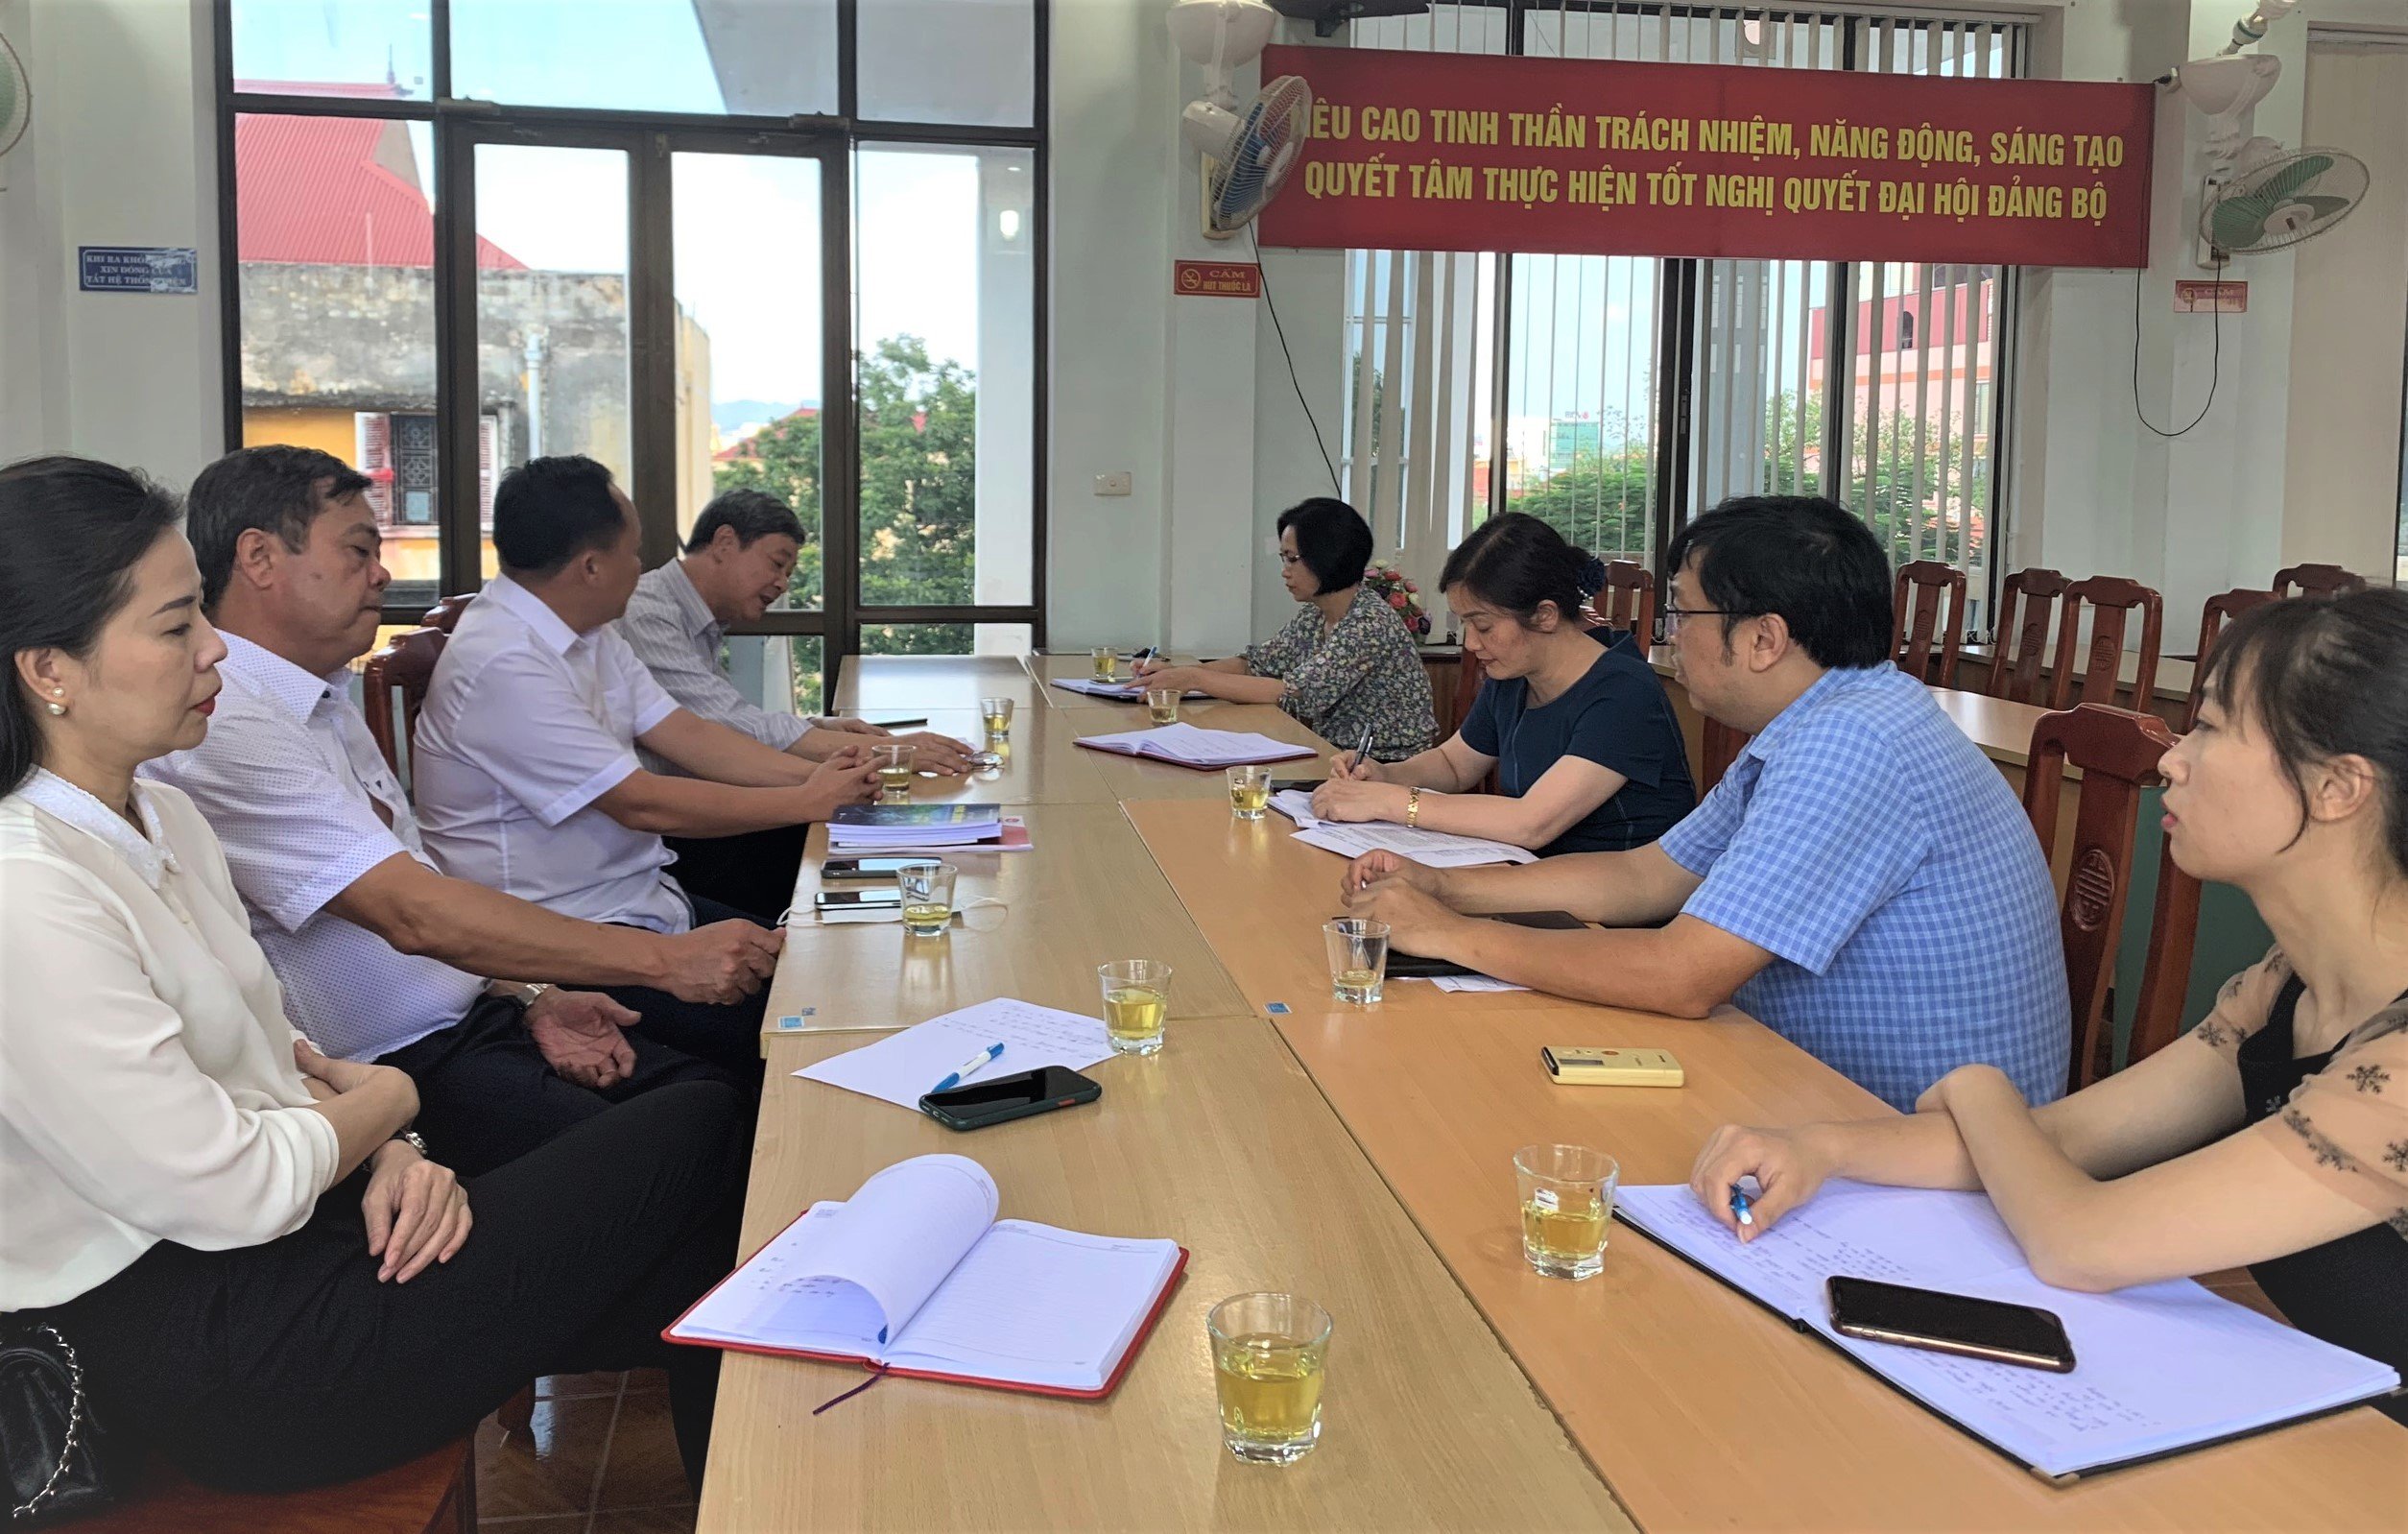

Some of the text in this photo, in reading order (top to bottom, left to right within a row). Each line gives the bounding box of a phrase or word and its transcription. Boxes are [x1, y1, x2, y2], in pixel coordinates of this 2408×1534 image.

[1361, 106, 1421, 142] CAO
[1430, 109, 1499, 145] TINH
[1509, 103, 1585, 148] THẦN
[1595, 110, 1689, 152] TRÁCH
[1699, 115, 1800, 161] NHIỆM,
[1809, 118, 1889, 159] NĂNG
[1896, 122, 1981, 168] ĐỘNG,
[1990, 127, 2065, 166] SÁNG
[2073, 134, 2124, 174] TẠO
[1304, 153, 2108, 227] QUYẾT TÂM THỰC HIỆN TỐT NGHỊ QUYẾT ĐẠI HỘI ĐẢNG BỘ
[100, 265, 118, 274] XIN
[107, 254, 121, 264] RA
